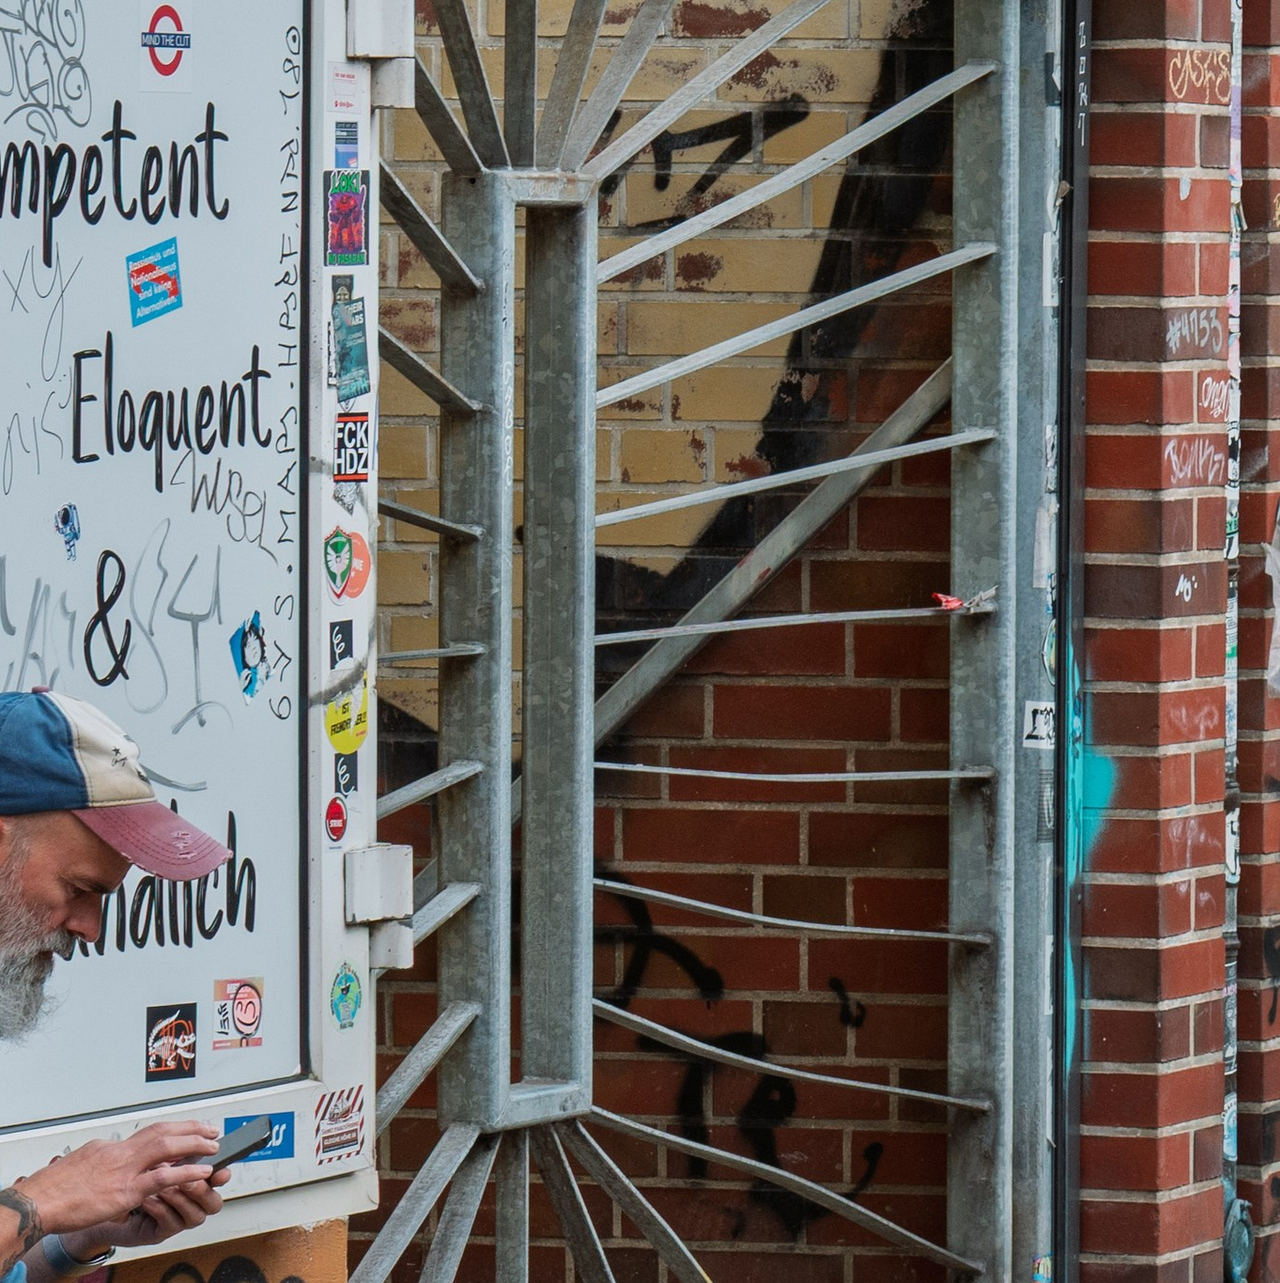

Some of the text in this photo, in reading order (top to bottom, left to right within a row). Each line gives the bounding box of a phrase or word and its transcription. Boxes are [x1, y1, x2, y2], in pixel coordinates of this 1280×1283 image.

[142, 33, 161, 47] MIND
[161, 34, 174, 47] THE
[330, 171, 361, 194] LOKI
[162, 243, 176, 258] und
[130, 262, 177, 287] Nationalismus
[139, 280, 173, 301] sind keine
[348, 313, 365, 326] ARS
[70, 330, 272, 494] Eloquent
[334, 421, 368, 448] FCK
[333, 447, 368, 475] HDZ
[83, 549, 132, 686] &
